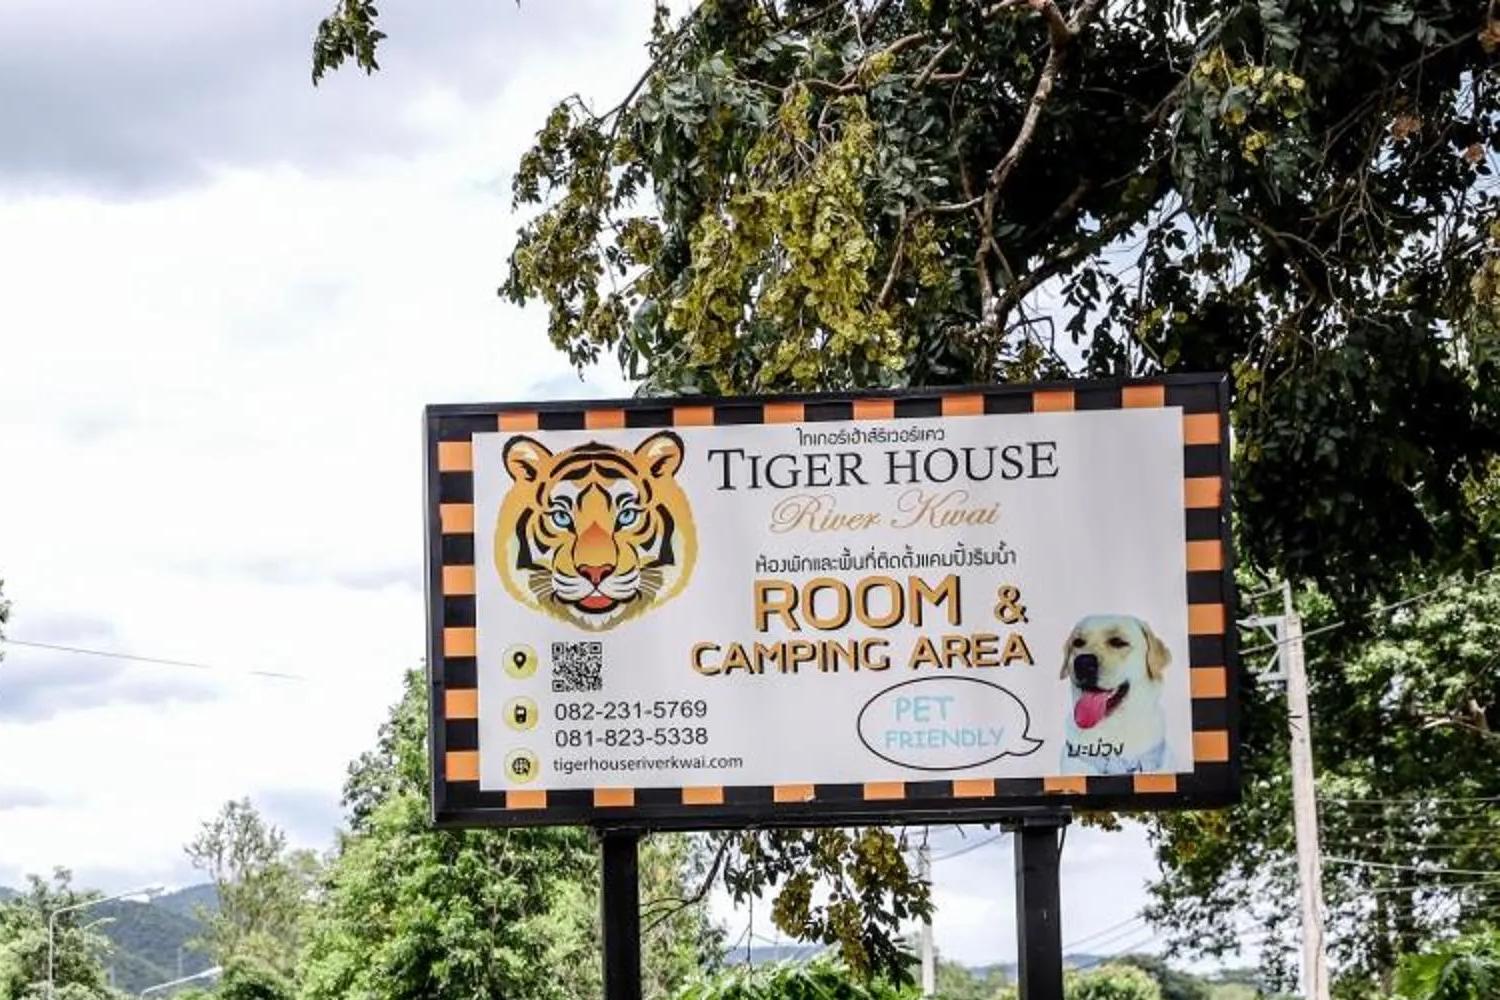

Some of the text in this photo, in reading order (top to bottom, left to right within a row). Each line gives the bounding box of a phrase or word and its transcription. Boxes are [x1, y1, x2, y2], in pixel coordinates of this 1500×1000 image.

[707, 441, 1059, 490] TIGER HOUSE
[769, 489, 1001, 534] River Kwai
[753, 573, 1029, 632] ROOM &
[690, 632, 1036, 676] CAMPING AREA
[554, 700, 708, 721] 082-231-5769
[893, 695, 955, 723] PET
[554, 727, 709, 748] 081-823-5338
[885, 728, 1005, 750] FRIENDLY
[1065, 737, 1125, 758] มะม่วง
[553, 754, 743, 776] tigerhouseriverkwai.com
